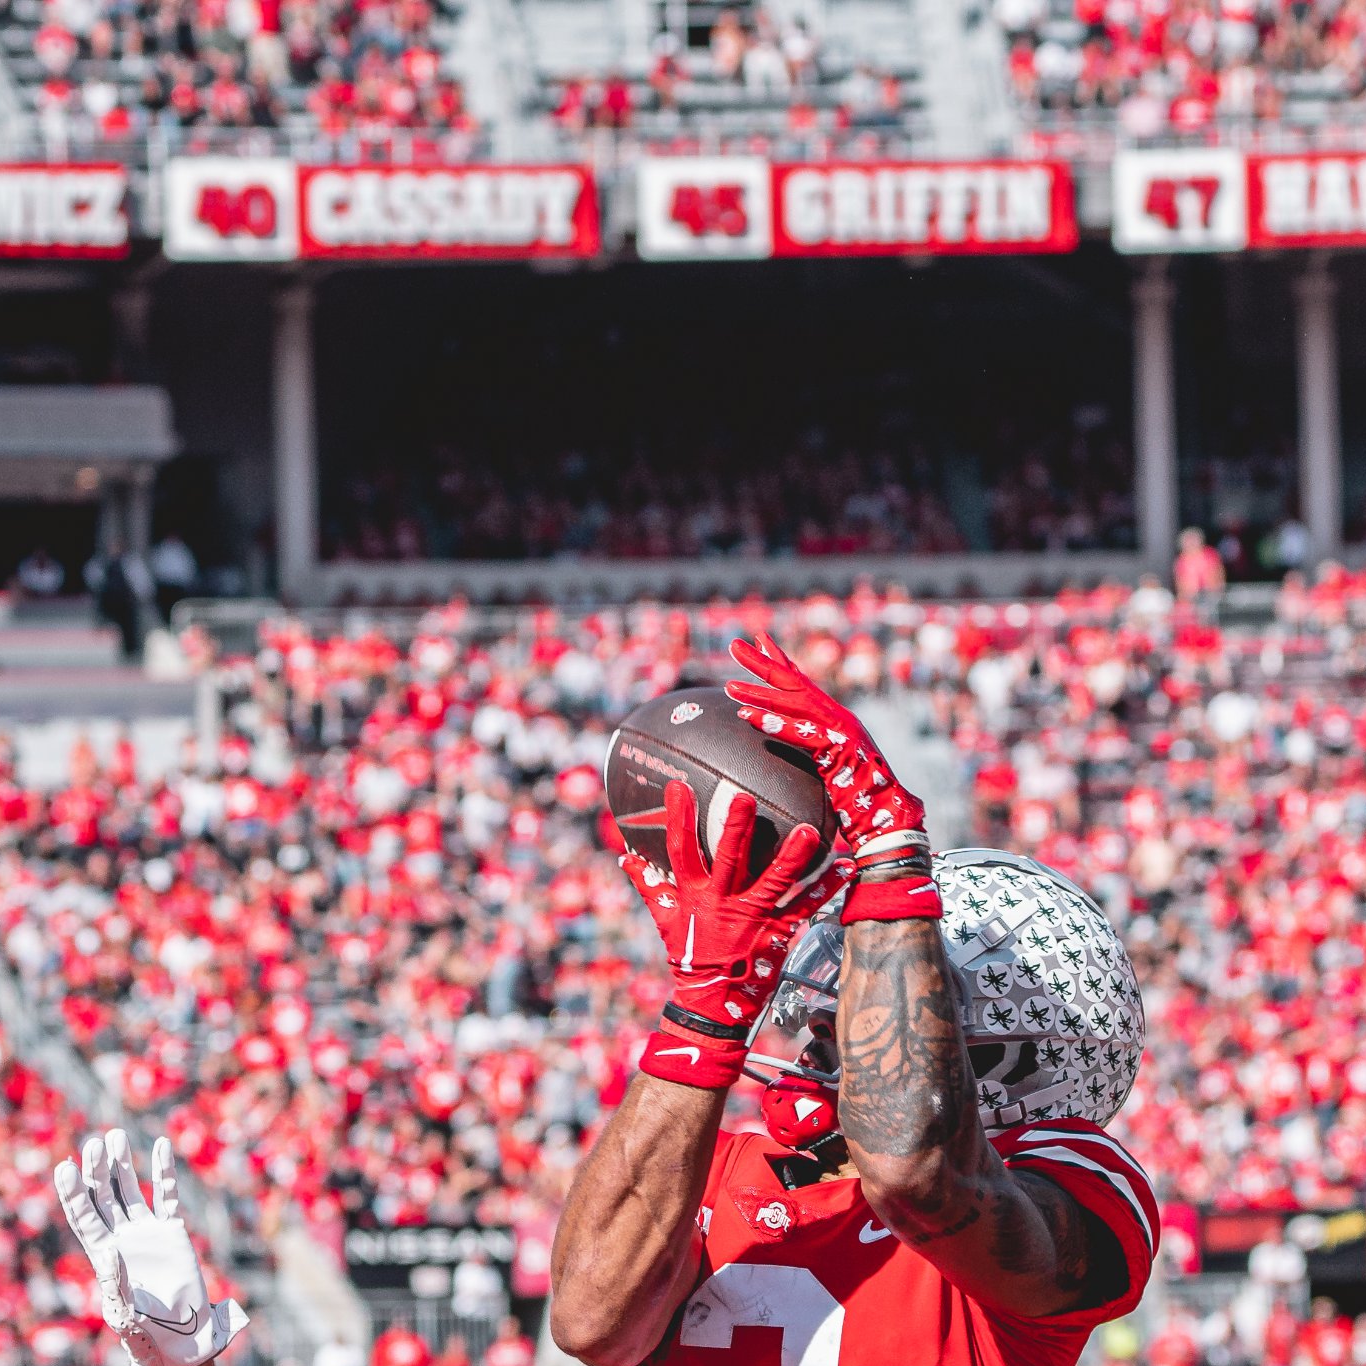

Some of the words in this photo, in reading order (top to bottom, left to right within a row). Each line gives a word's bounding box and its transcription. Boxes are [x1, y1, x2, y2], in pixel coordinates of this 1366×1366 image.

[198, 181, 275, 237] 40
[310, 170, 580, 246] CASSADY
[673, 182, 747, 235] 45
[786, 168, 1051, 244] GRIFFIN
[1146, 177, 1219, 228] 47
